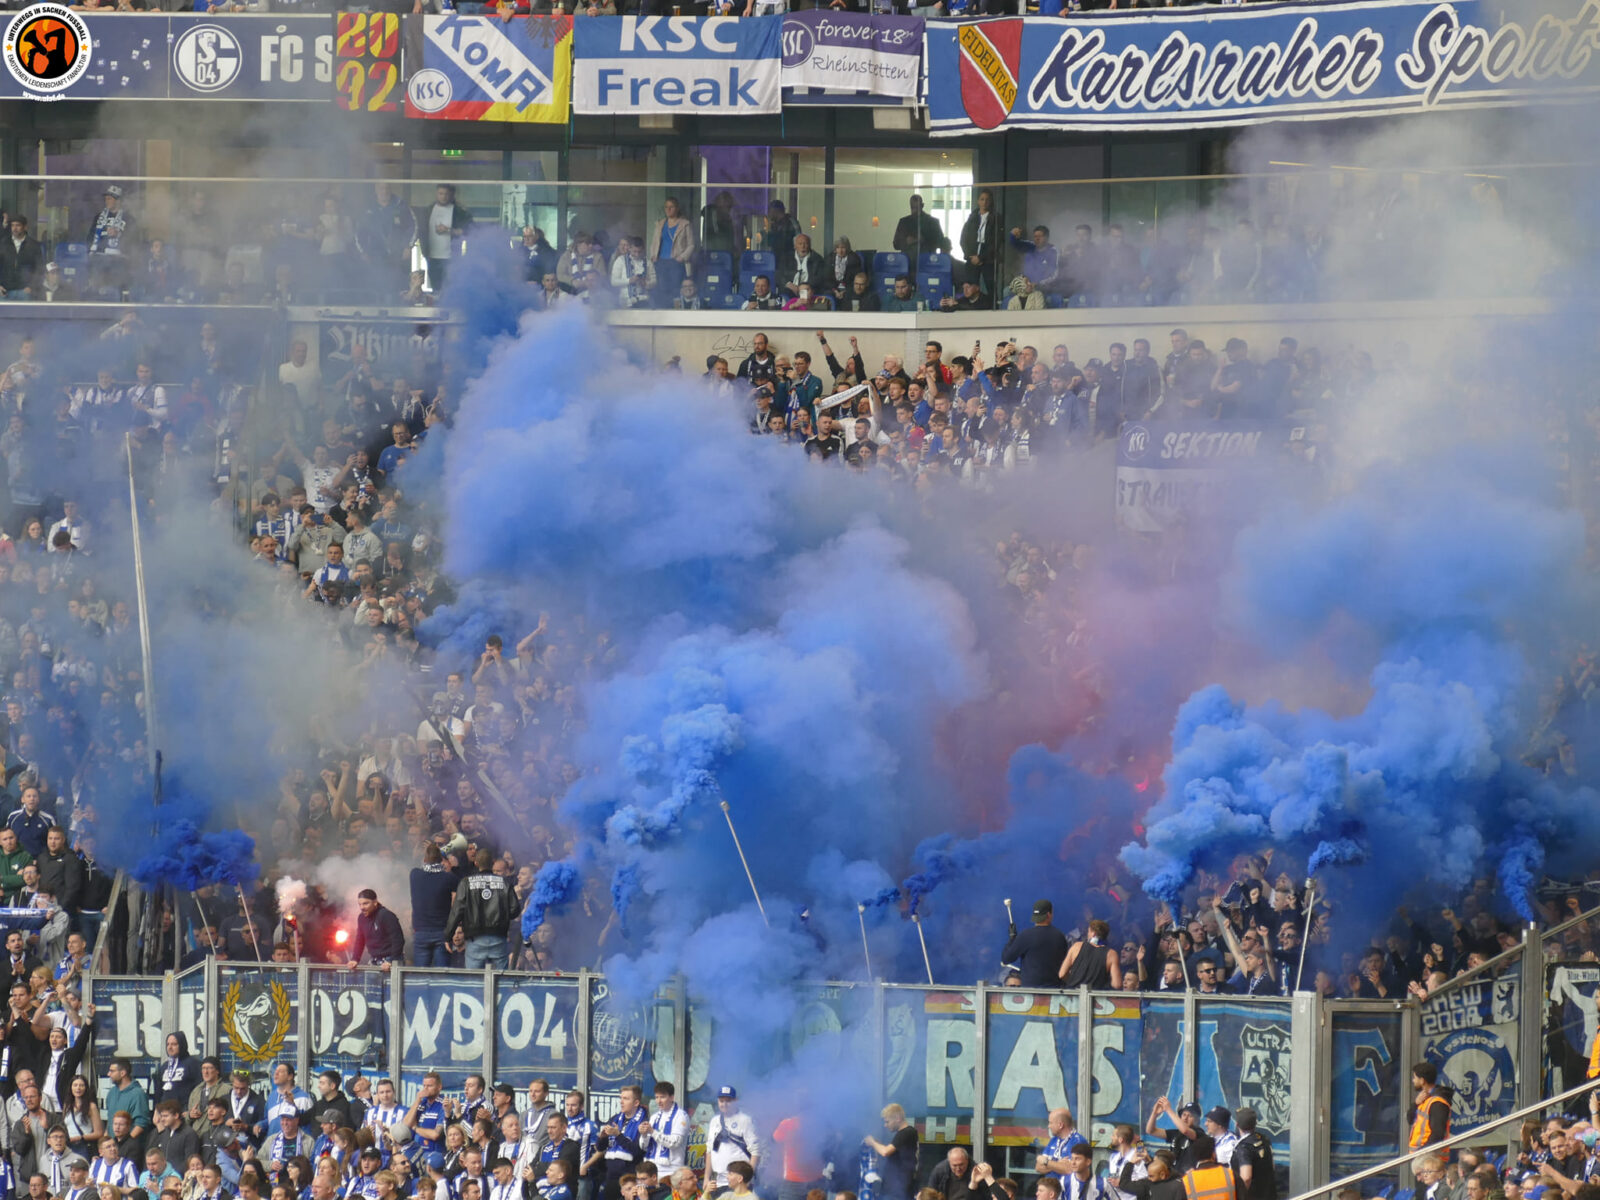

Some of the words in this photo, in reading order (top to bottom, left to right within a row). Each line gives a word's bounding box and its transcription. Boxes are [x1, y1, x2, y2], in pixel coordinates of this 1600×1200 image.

[620, 15, 740, 53] KSC
[815, 20, 879, 41] forever
[260, 34, 304, 82] FC
[812, 54, 913, 79] Rheinstetten
[963, 29, 1015, 105] FIDELITAS
[1028, 17, 1384, 110] Karlsruher
[336, 60, 398, 112] 92
[416, 80, 444, 99] KSC
[598, 67, 760, 107] Freak
[1160, 431, 1262, 460] SEKTION
